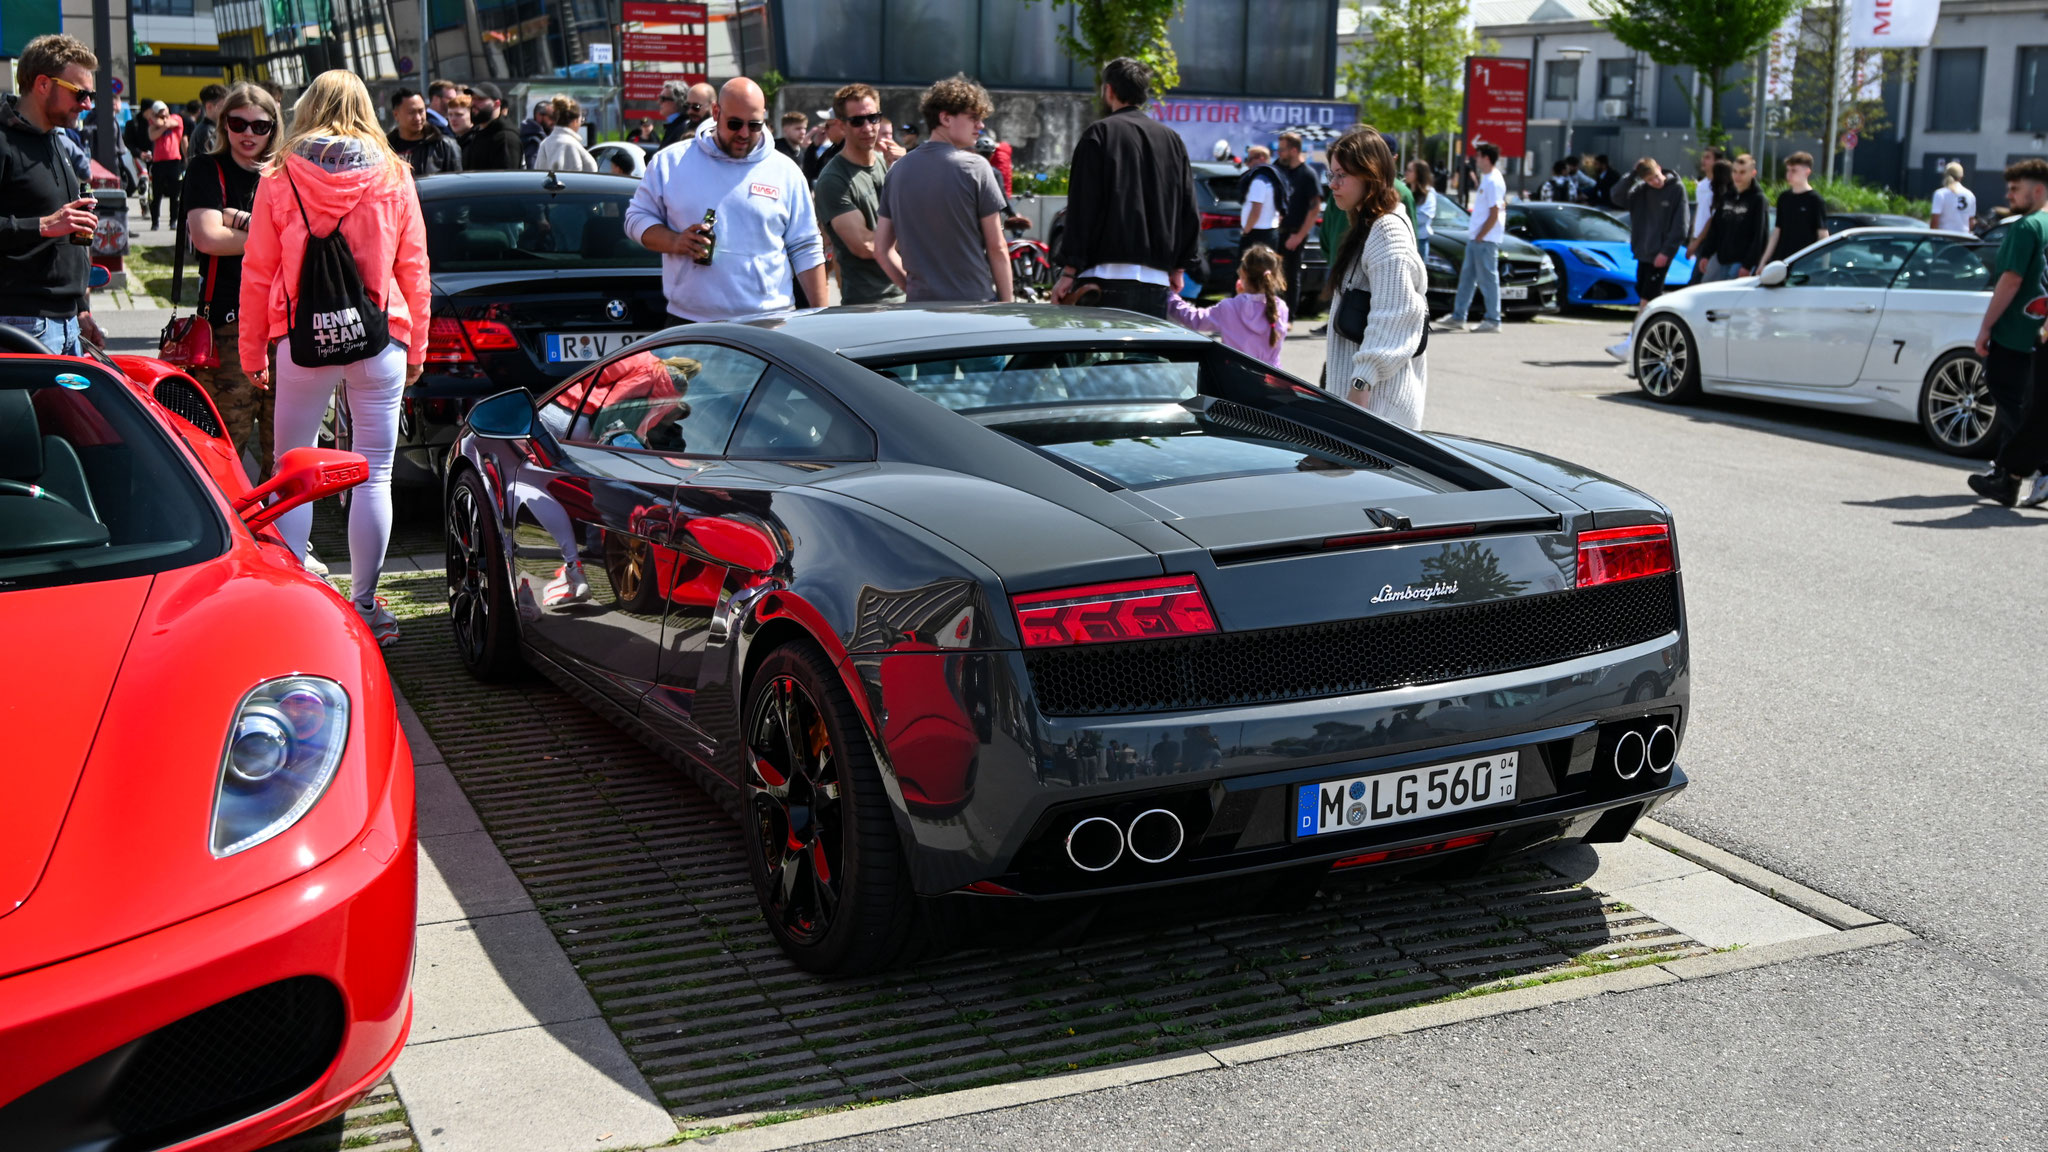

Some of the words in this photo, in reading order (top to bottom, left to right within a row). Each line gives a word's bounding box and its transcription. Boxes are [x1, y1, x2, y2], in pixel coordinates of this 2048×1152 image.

[1153, 102, 1240, 123] MOTOR
[1248, 104, 1334, 126] WORLD
[1956, 196, 1968, 211] 3
[312, 306, 362, 330] DENIM
[314, 343, 341, 358] Together
[342, 340, 369, 354] Stronger
[563, 336, 578, 358] R
[593, 336, 607, 358] V
[1893, 339, 1906, 365] 7
[1370, 580, 1459, 604] Lamborghini
[1500, 756, 1514, 770] 04
[1499, 784, 1513, 797] 10
[1320, 785, 1345, 829] M
[1302, 815, 1311, 828] D
